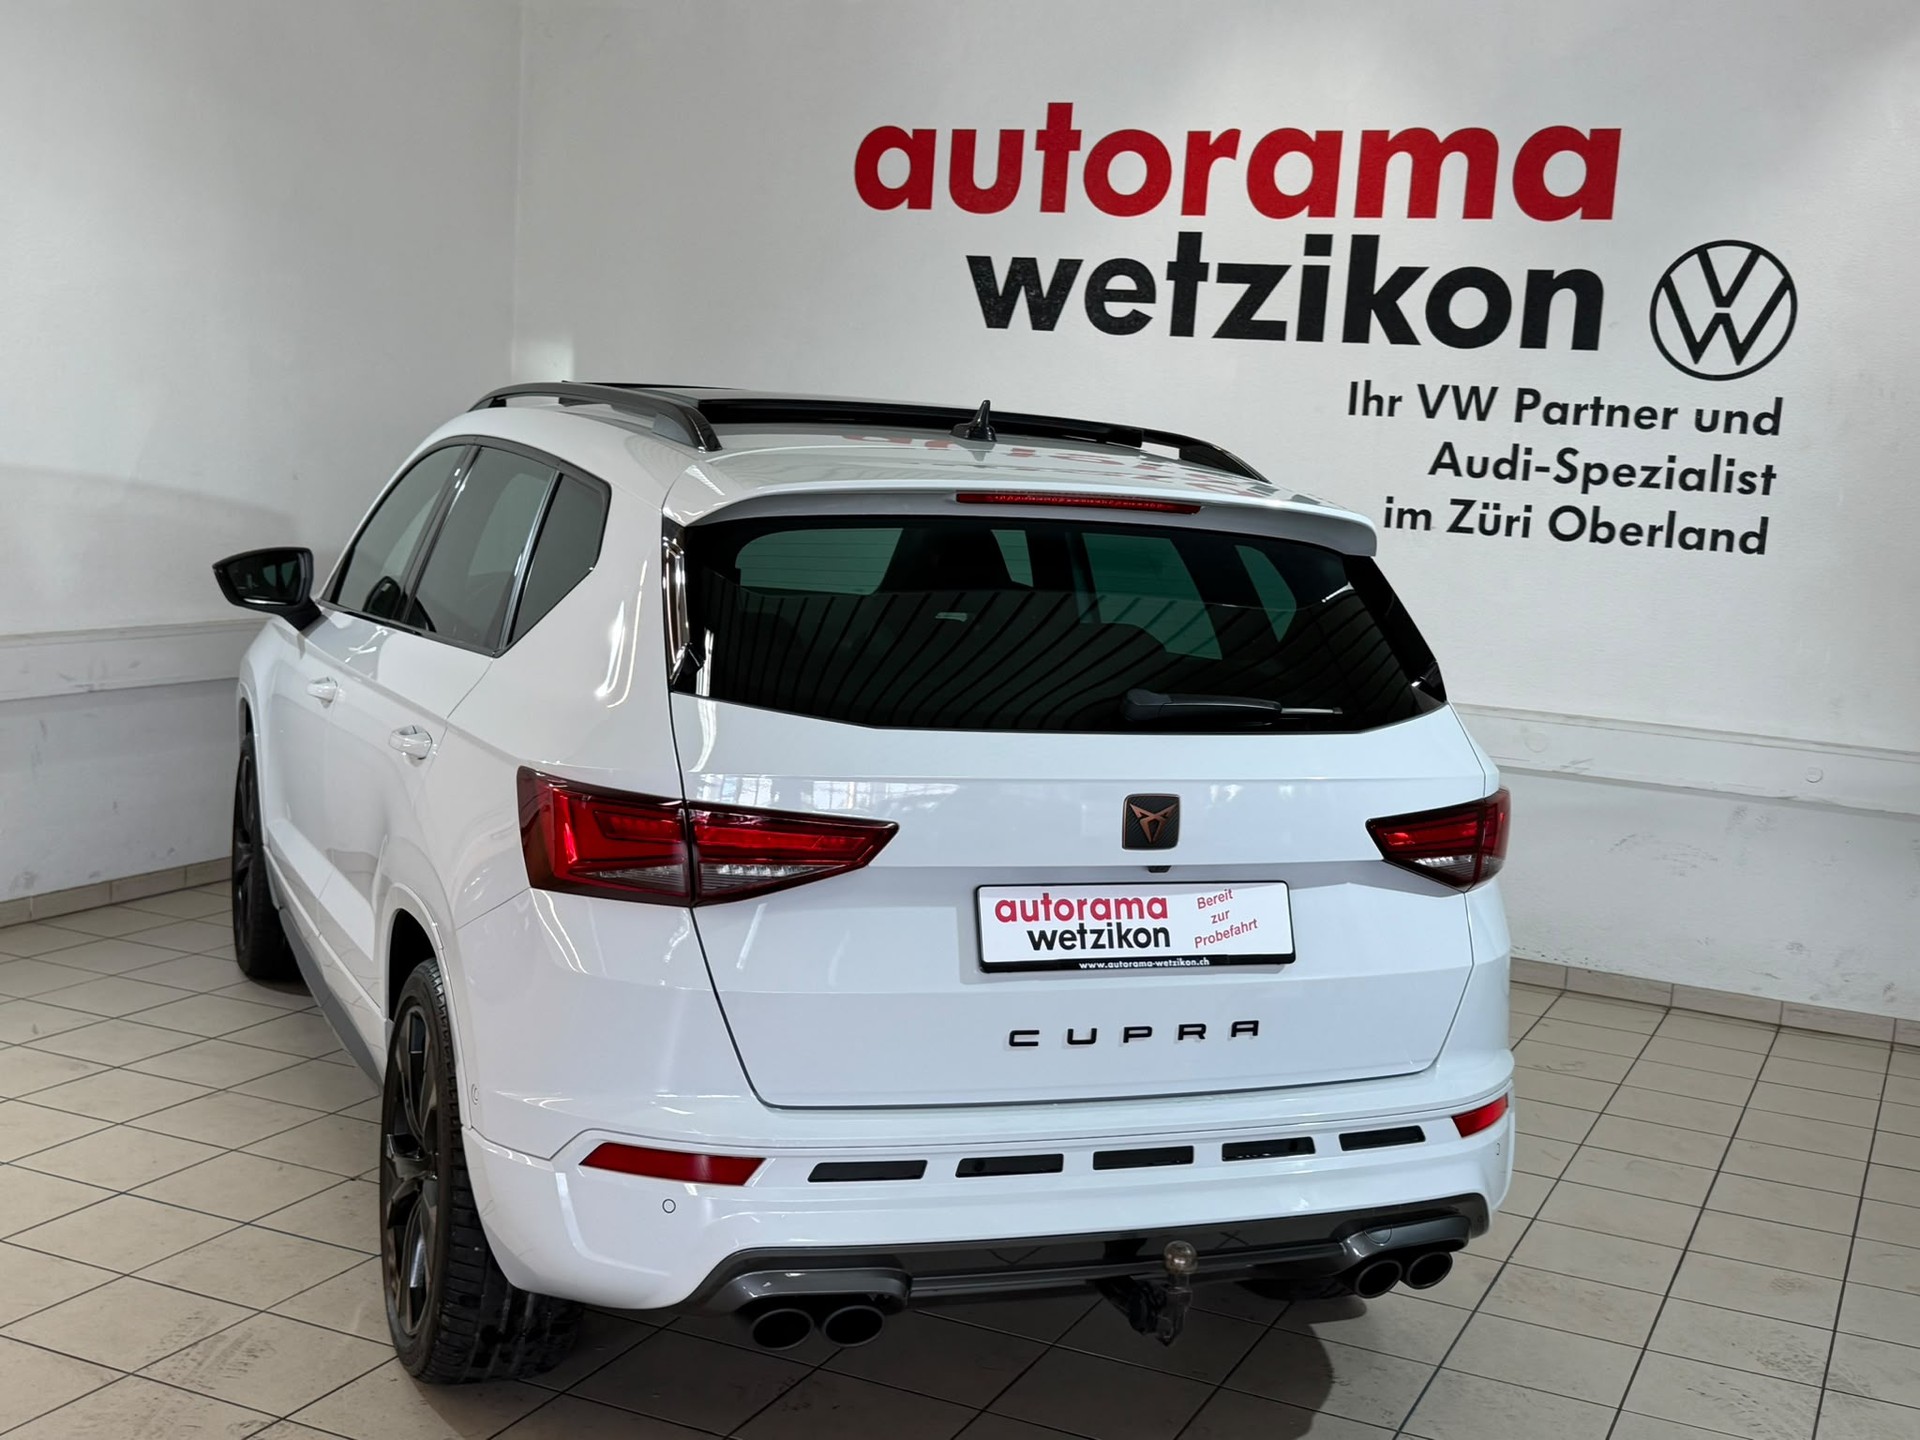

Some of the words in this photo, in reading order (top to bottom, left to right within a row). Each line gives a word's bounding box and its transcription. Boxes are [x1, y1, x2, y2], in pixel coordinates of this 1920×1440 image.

[854, 102, 1622, 221] autorama
[966, 232, 1605, 351] wetzikon
[1348, 380, 1403, 417] Ihr
[1416, 384, 1499, 422] VW
[1514, 387, 1679, 430] Partner
[1694, 397, 1784, 436] und
[1427, 441, 1777, 496] Audi-Spezialist
[1383, 496, 1433, 531] im
[1447, 498, 1533, 538] Züri
[1548, 505, 1770, 555] Oberland
[994, 893, 1169, 922] autorama
[1196, 888, 1234, 910] Bereit
[1210, 908, 1231, 924] zur
[1027, 922, 1171, 951] wetzikon
[1194, 918, 1258, 948] Probefahrt
[1079, 957, 1210, 970] www.autorama-wetzikon.ch
[1008, 1020, 1259, 1047] CUPRA
